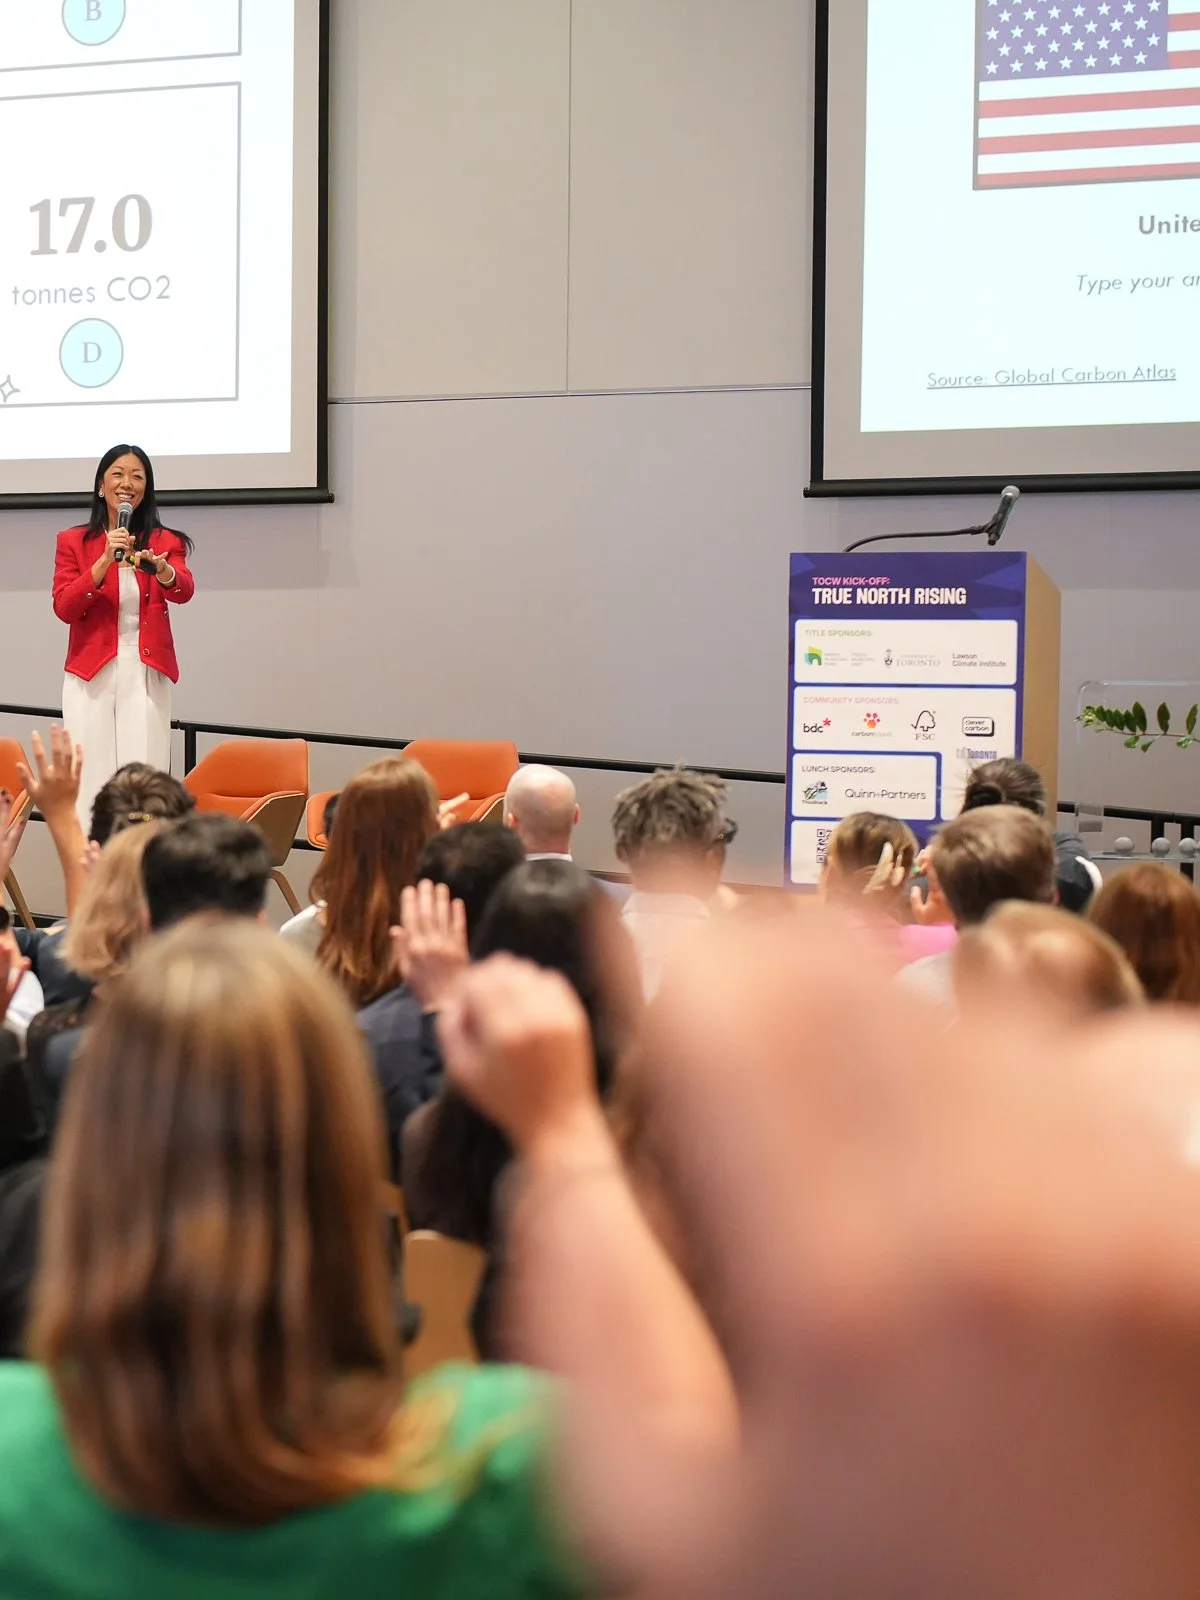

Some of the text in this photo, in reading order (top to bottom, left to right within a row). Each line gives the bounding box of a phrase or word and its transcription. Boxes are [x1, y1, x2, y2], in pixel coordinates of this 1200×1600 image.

[85, 0, 102, 21] B
[29, 194, 153, 255] 17.0
[12, 275, 171, 305] tonnes CO2
[1077, 274, 1122, 296] Type
[1130, 275, 1175, 294] your
[82, 341, 102, 363] D
[927, 364, 1177, 388] Source: Global Carbon Atlas
[812, 576, 890, 586] TOCW KICK-OFF:
[812, 587, 967, 605] TRUE NORTH RISING
[804, 629, 826, 637] TITLE
[896, 659, 941, 667] TORONTO
[978, 660, 1007, 668] Institute
[803, 696, 853, 704] COMMUNITY
[801, 765, 829, 773] LUNCH
